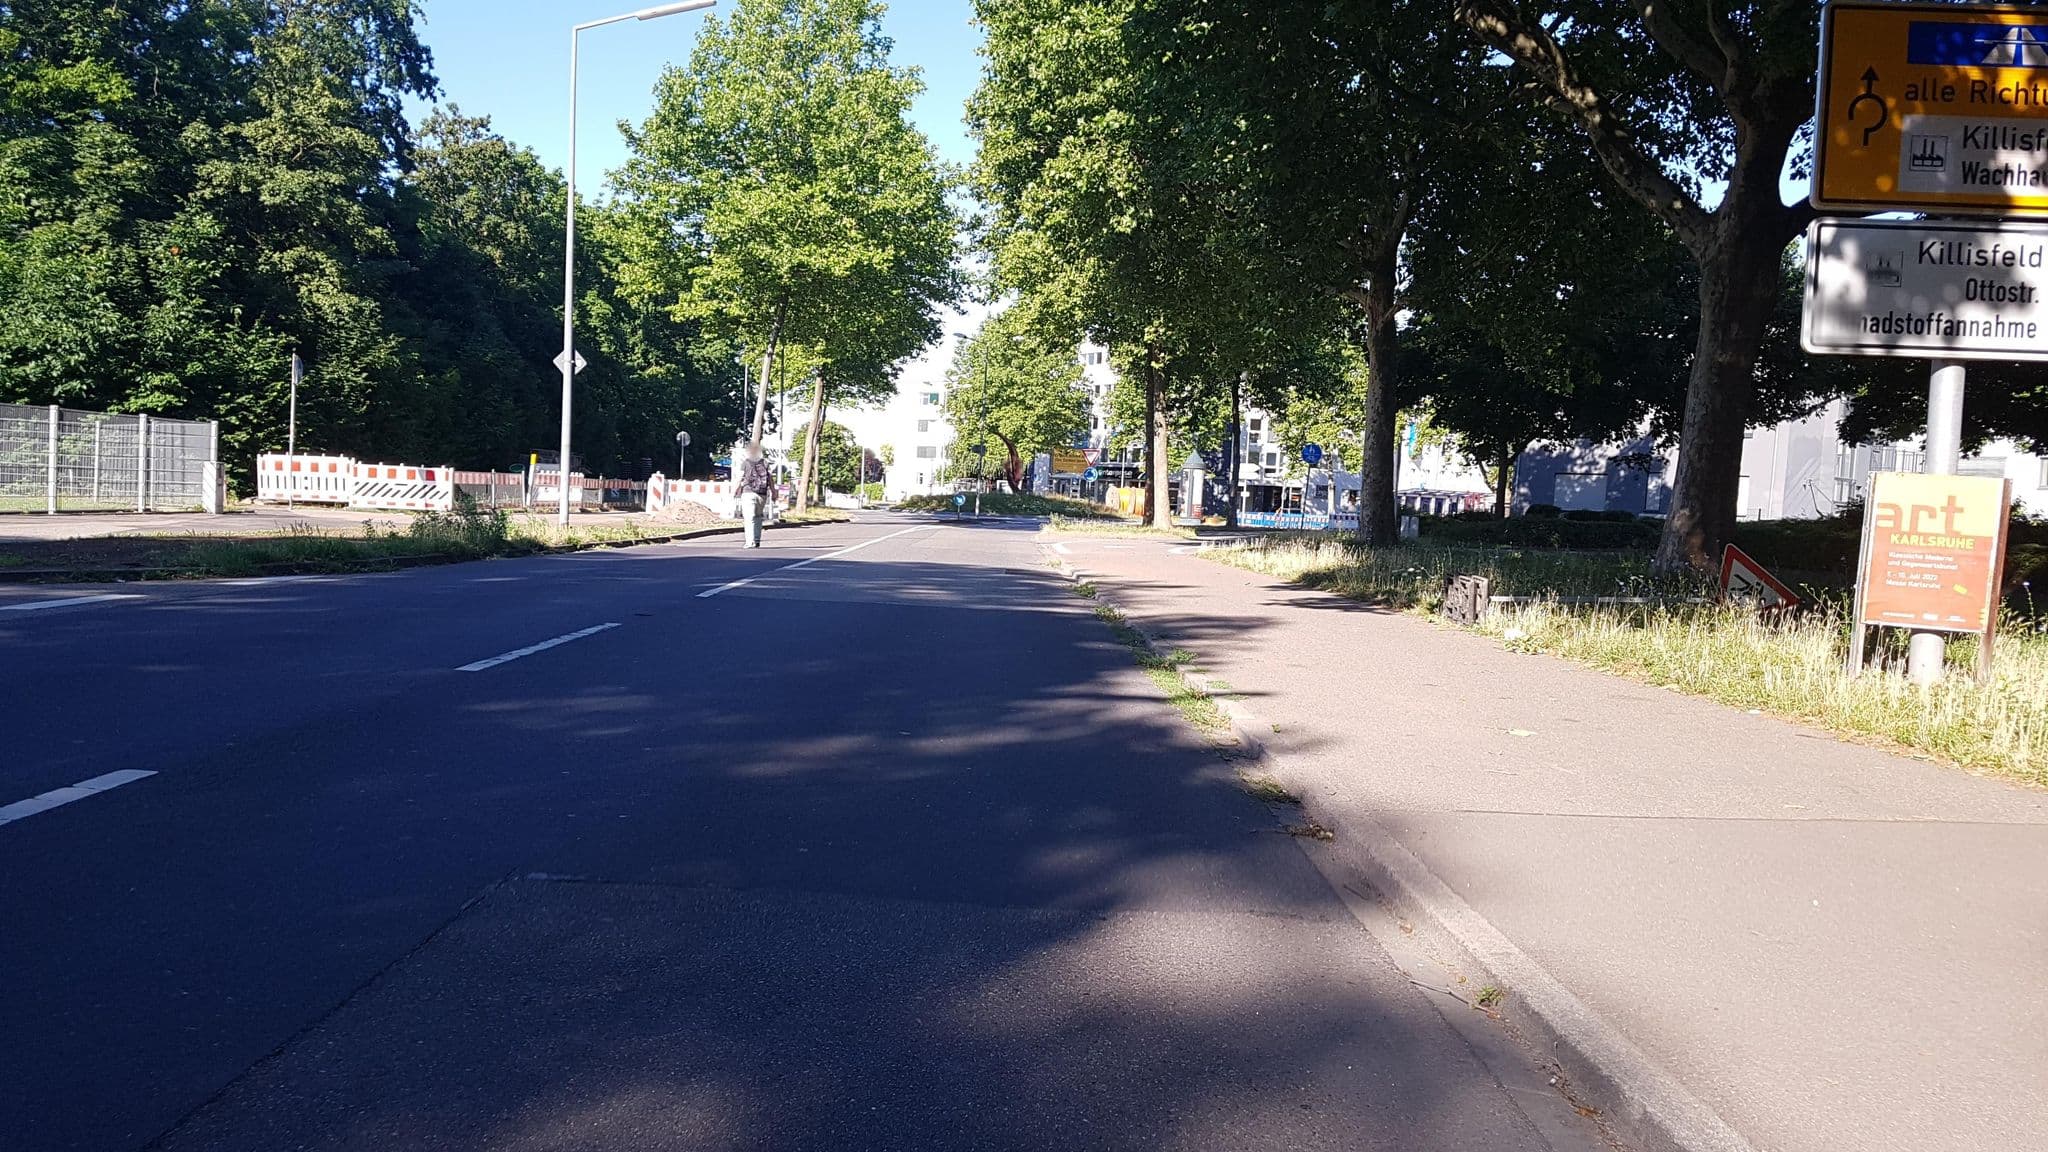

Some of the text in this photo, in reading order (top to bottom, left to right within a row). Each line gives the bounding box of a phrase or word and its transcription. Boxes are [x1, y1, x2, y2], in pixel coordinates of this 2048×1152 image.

[1904, 78, 1956, 102] alle
[1962, 125, 2048, 151] Killisf
[1918, 240, 2043, 268] Killisfeld
[1965, 278, 2039, 303] Ottostr.
[1876, 495, 1964, 535] art
[1890, 533, 1975, 550] KARLSRUHE
